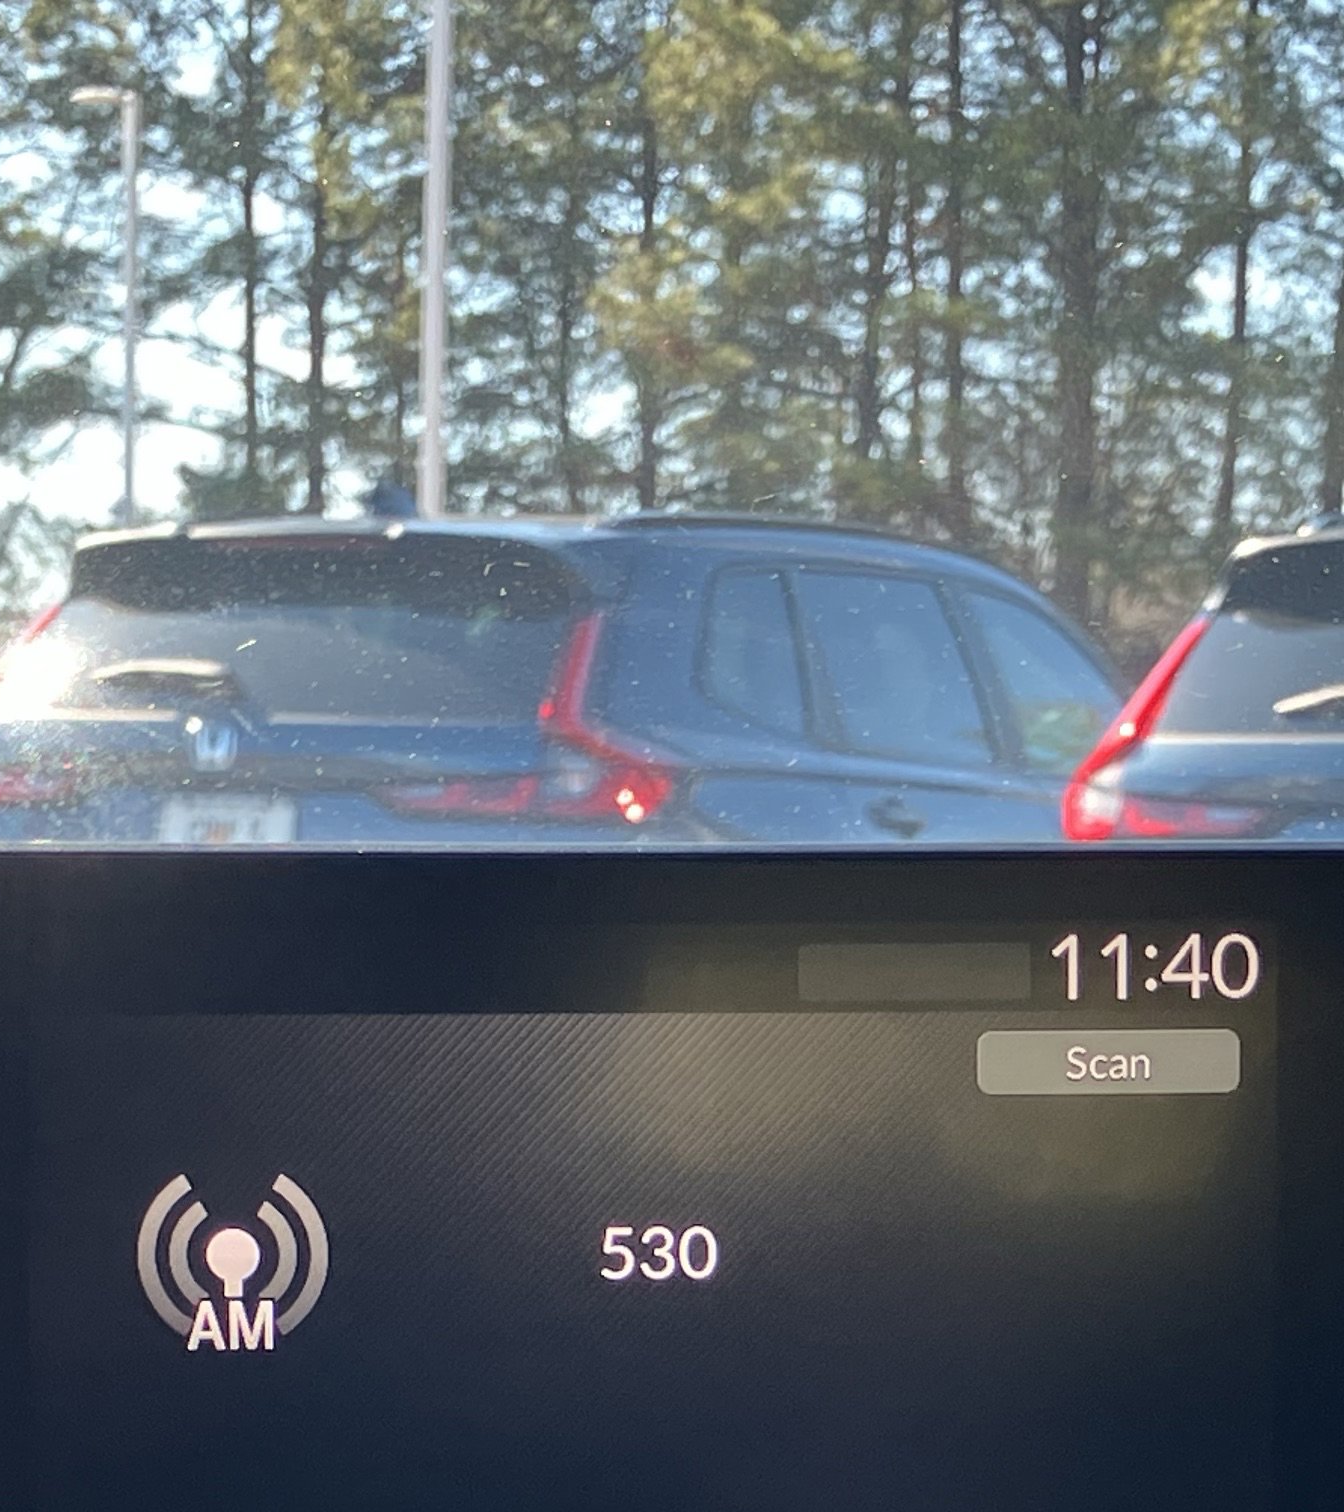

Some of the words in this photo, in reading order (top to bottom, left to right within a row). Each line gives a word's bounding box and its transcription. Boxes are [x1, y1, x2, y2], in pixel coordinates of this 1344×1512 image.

[1052, 934, 1258, 1000] 11:40
[1067, 1047, 1149, 1079] Scan
[601, 1226, 717, 1280] 530
[187, 1301, 275, 1351] AM
